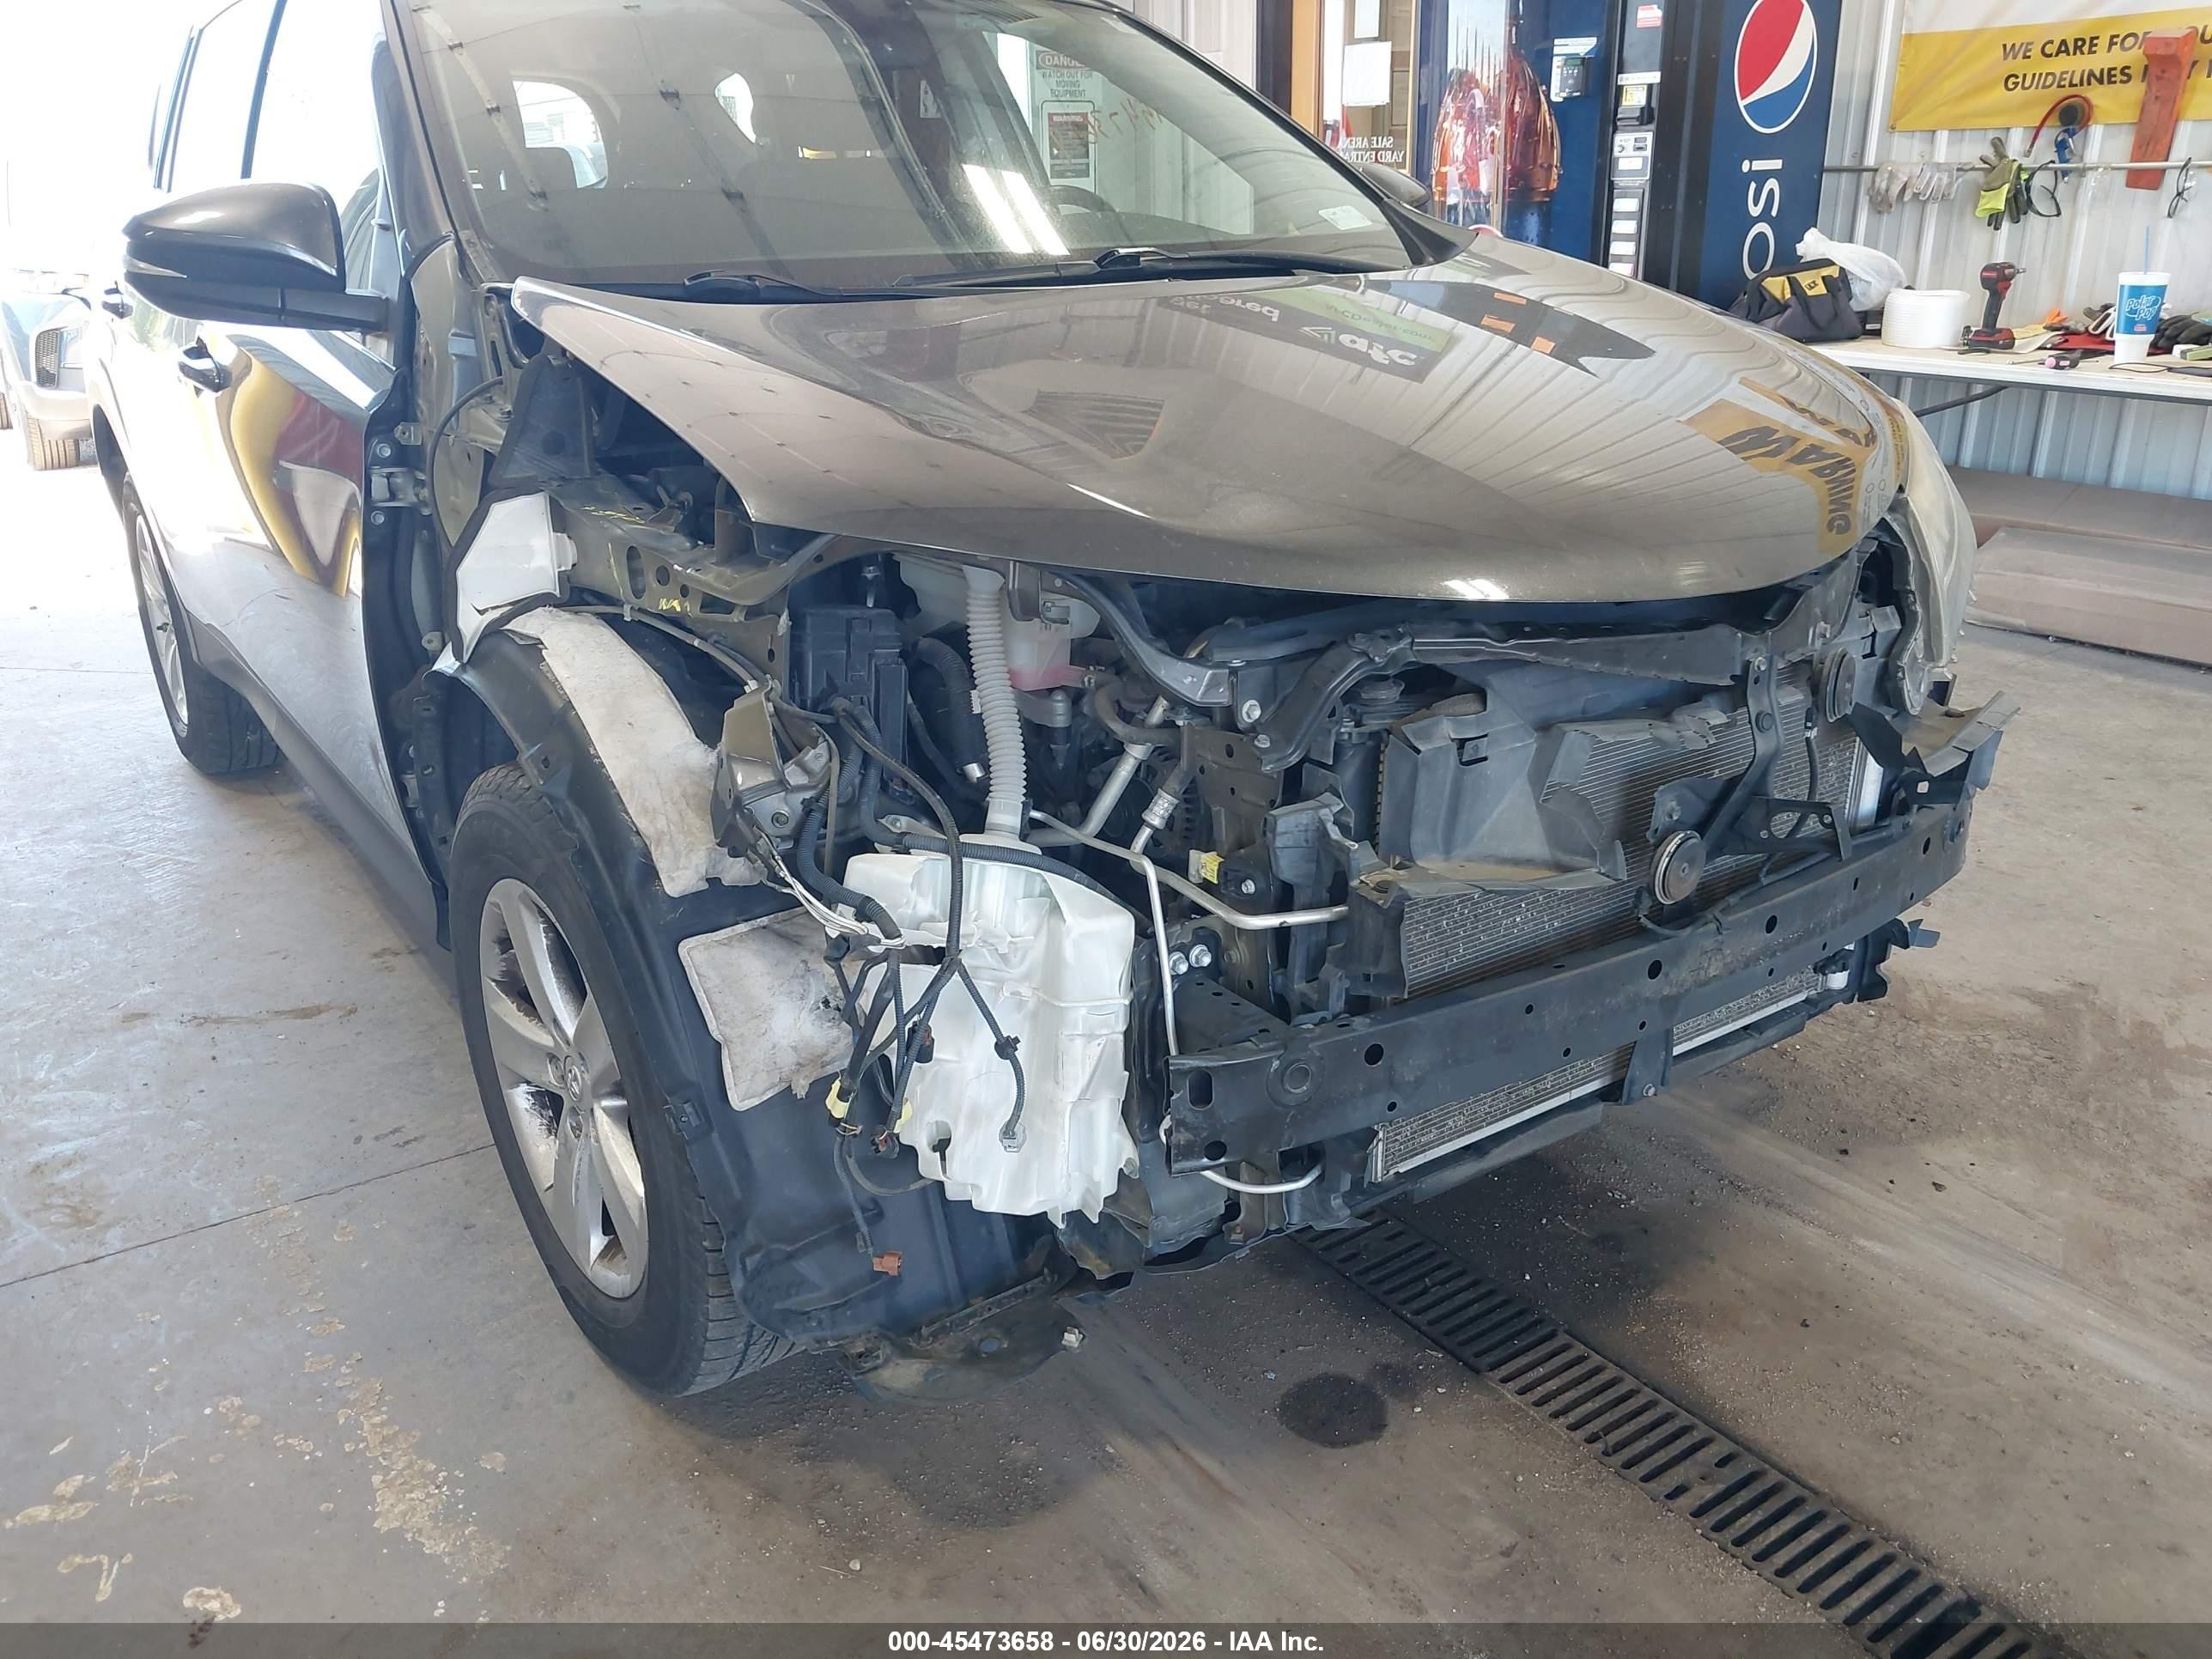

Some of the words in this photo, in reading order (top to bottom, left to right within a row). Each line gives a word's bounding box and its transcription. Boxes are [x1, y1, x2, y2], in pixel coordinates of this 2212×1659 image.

[2002, 40, 2034, 61] WE
[2040, 35, 2100, 58] CARE
[2003, 65, 2132, 92] GUIDELINES
[1050, 88, 1086, 97] EQUIPMENT
[2126, 295, 2156, 310] Polar
[2136, 307, 2157, 321] Pop
